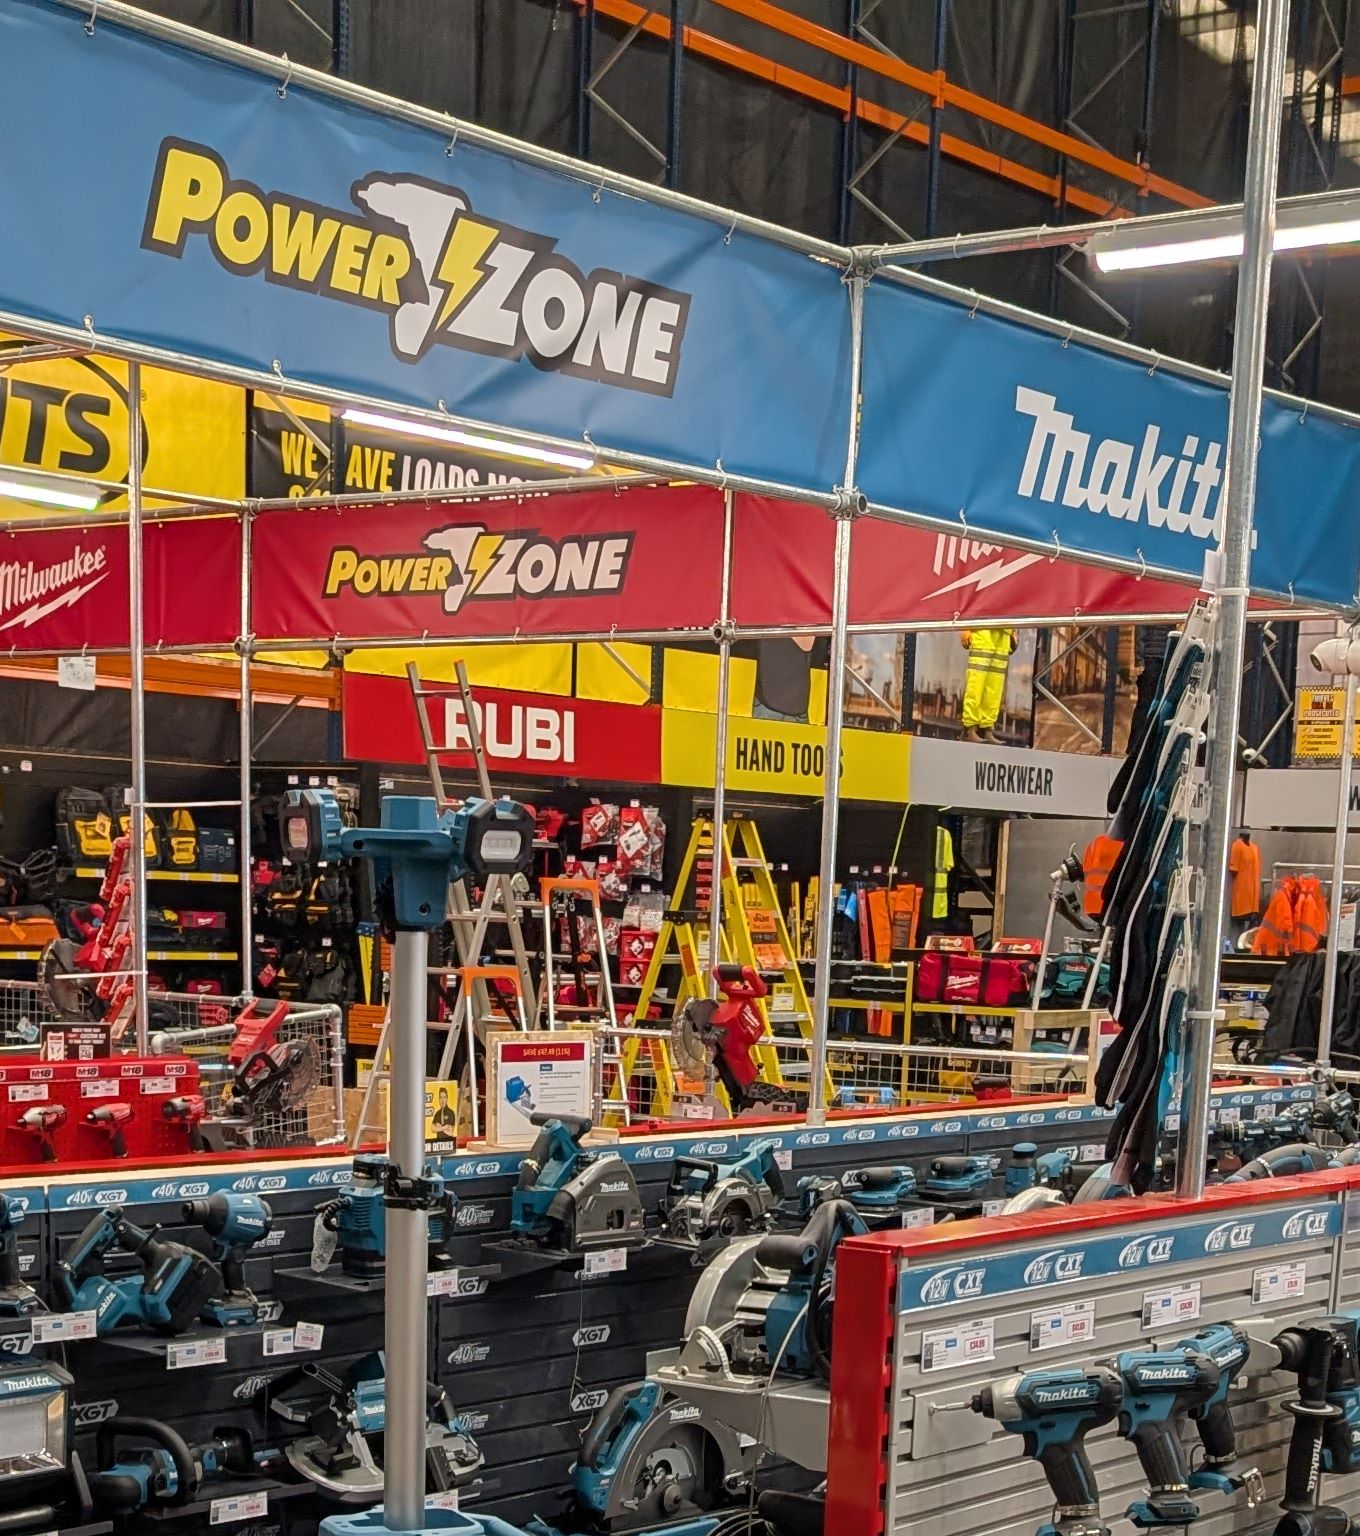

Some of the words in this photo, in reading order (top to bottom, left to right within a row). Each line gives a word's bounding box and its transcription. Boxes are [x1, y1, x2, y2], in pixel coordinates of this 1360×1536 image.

[446, 240, 682, 386] ZONE
[281, 431, 320, 480] WE
[328, 445, 396, 492] AVE
[1016, 386, 1258, 550] Makit
[472, 538, 628, 595] ZONE
[444, 698, 576, 764] RUBI
[736, 736, 784, 775] HAND
[974, 761, 1053, 798] WORKWEAR
[947, 975, 980, 988] Milwaukee
[29, 1068, 54, 1079] M18
[76, 1066, 99, 1077] M18
[121, 1065, 144, 1076] M18
[165, 1064, 186, 1075] M18
[656, 1146, 674, 1157] XGT
[478, 1161, 500, 1174] XGT
[181, 1183, 208, 1195] XGT
[261, 1176, 285, 1189] XGT
[98, 1190, 126, 1203] XGT
[1306, 1212, 1330, 1235] CXT
[1230, 1223, 1256, 1248] CXT
[1147, 1237, 1175, 1263] CXT
[1055, 1252, 1086, 1279] CXT
[954, 1268, 986, 1297] CXT
[579, 1328, 606, 1343] XGT
[1140, 1367, 1189, 1382] Makita
[4, 1375, 53, 1391] Makita
[576, 1393, 605, 1409] XGT
[1036, 1386, 1090, 1404] Makita
